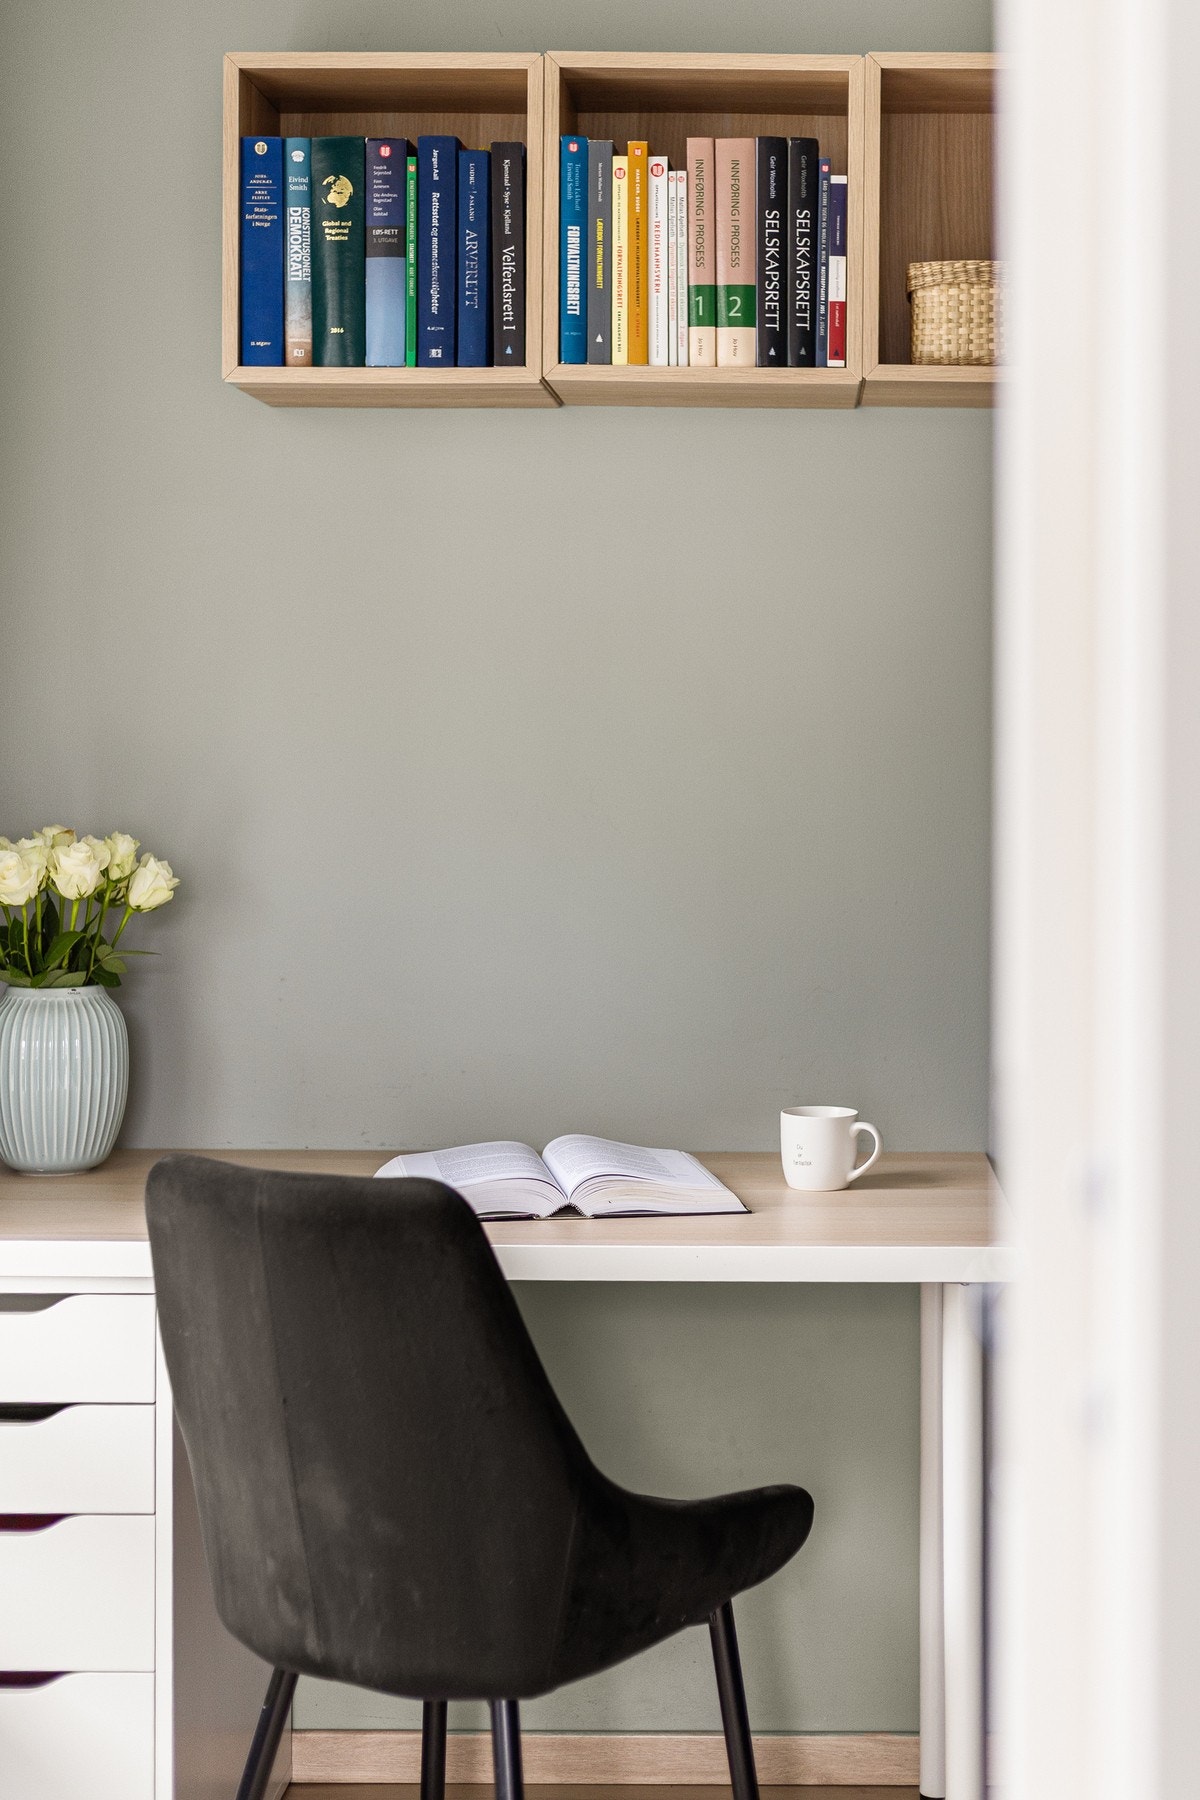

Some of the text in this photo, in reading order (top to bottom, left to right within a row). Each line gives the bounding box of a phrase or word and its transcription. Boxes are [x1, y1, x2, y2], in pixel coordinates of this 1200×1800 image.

[503, 191, 511, 204] Syse
[696, 159, 704, 216] INNFØRING
[731, 160, 740, 216] INNFØRING
[290, 206, 302, 282] DEMOKRATI
[302, 207, 311, 282] KONSTITUSJONELT
[431, 192, 440, 314] Rettsstat og menneskerettigheter
[503, 209, 512, 234] Kjelland
[696, 224, 704, 267] PROSESS
[731, 225, 740, 268] PROSESS
[466, 230, 478, 308] ARVERETT
[502, 245, 516, 322] Velferdsrett
[567, 226, 580, 315] FORVALTNINGSRETT
[765, 210, 780, 331] SELSKAPSRETT
[796, 209, 811, 331] SELSKAPSRETT
[695, 296, 703, 316] 1
[728, 296, 741, 316] 2
